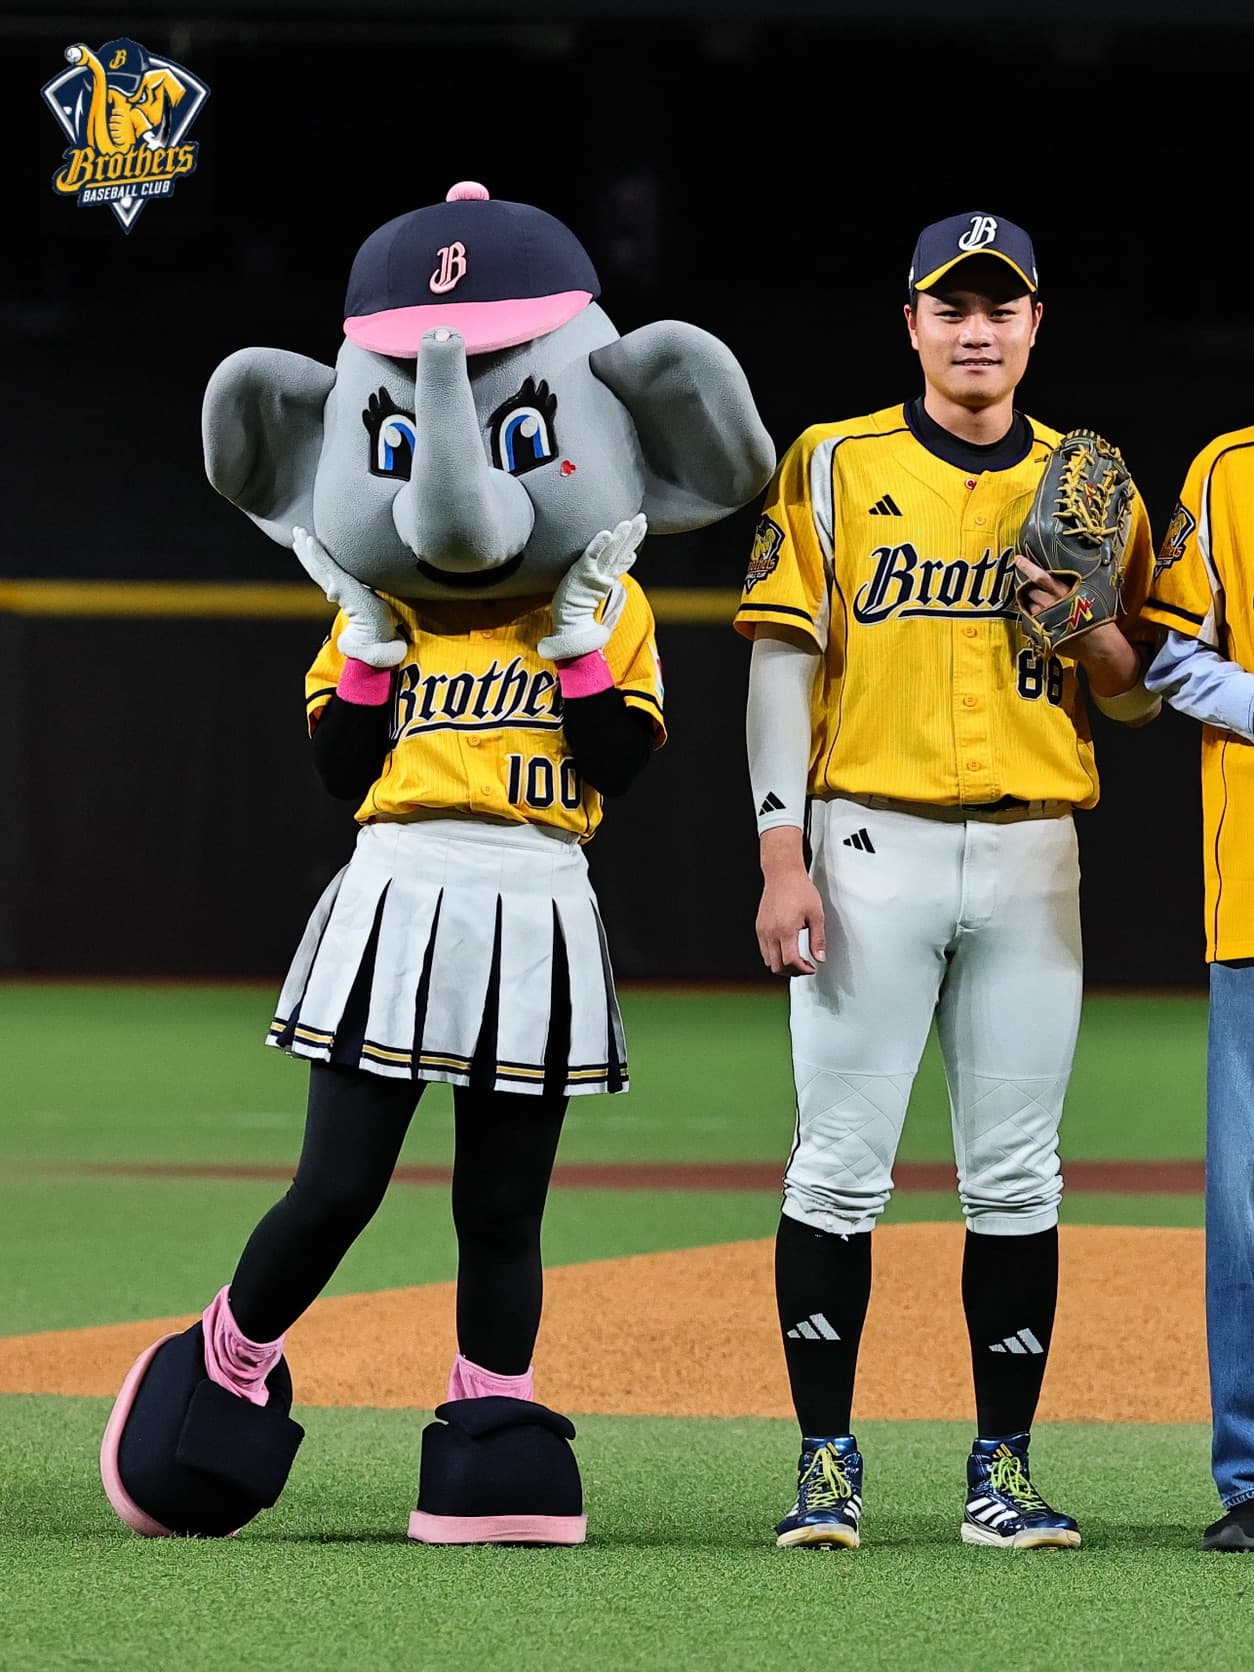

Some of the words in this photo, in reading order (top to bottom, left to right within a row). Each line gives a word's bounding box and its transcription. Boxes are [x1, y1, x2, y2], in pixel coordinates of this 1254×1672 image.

[958, 216, 998, 251] B
[429, 241, 467, 294] B
[1016, 648, 1063, 706] 88
[507, 753, 583, 811] 100
